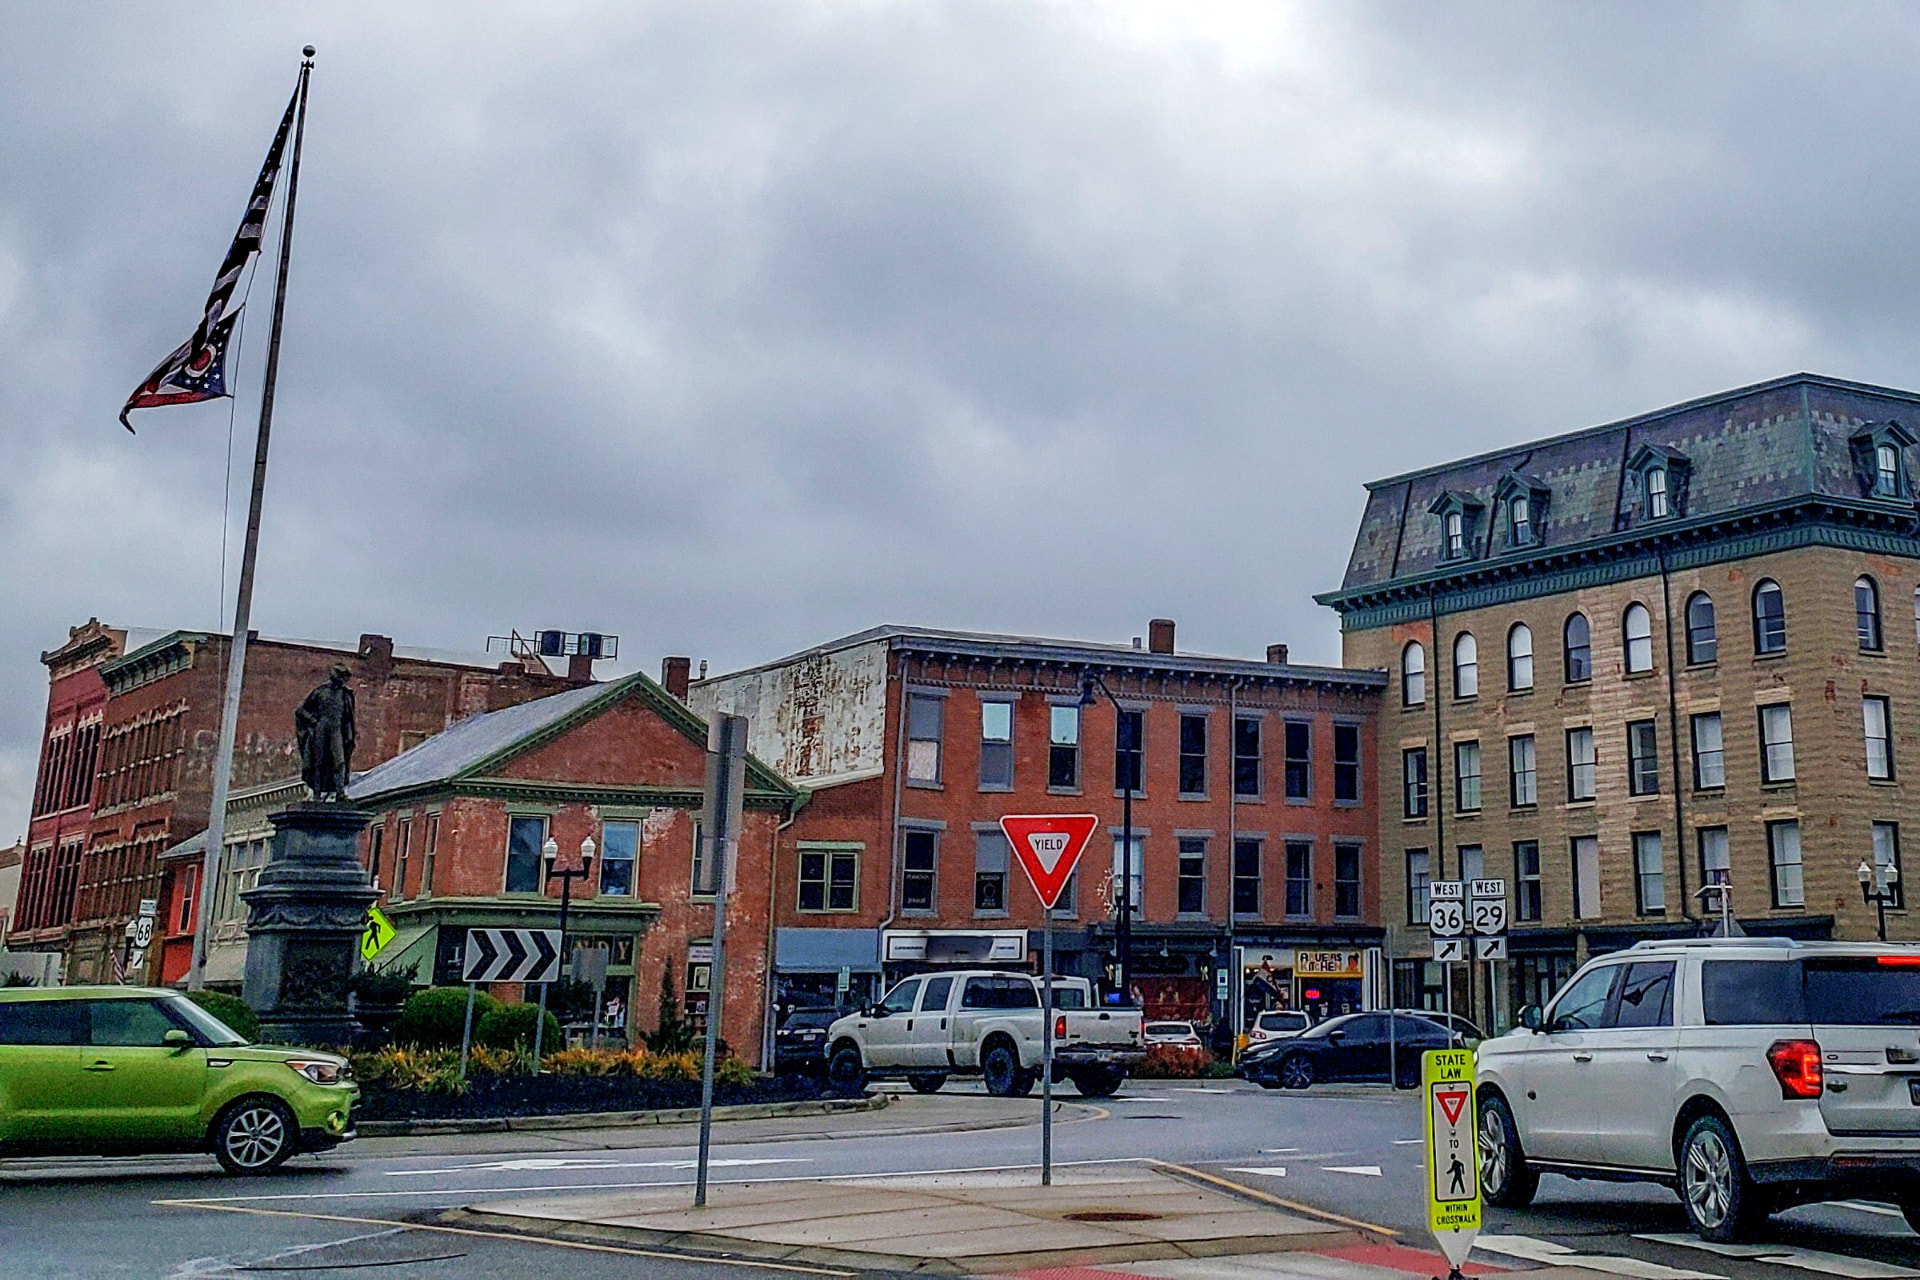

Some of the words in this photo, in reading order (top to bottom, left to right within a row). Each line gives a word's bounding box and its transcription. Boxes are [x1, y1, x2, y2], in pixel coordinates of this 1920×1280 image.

[1035, 839, 1062, 850] YIELD
[1434, 883, 1459, 896] WEST
[1476, 881, 1501, 894] WEST
[1434, 908, 1460, 929] 36
[1476, 906, 1502, 926] 29
[138, 924, 150, 941] 68
[1300, 962, 1342, 971] KITCHEN
[1435, 1054, 1466, 1066] STATE
[1440, 1067, 1461, 1079] LAW
[1449, 1139, 1459, 1149] TO
[1445, 1203, 1468, 1212] WITHIN
[1436, 1214, 1476, 1225] CROSSWALK
